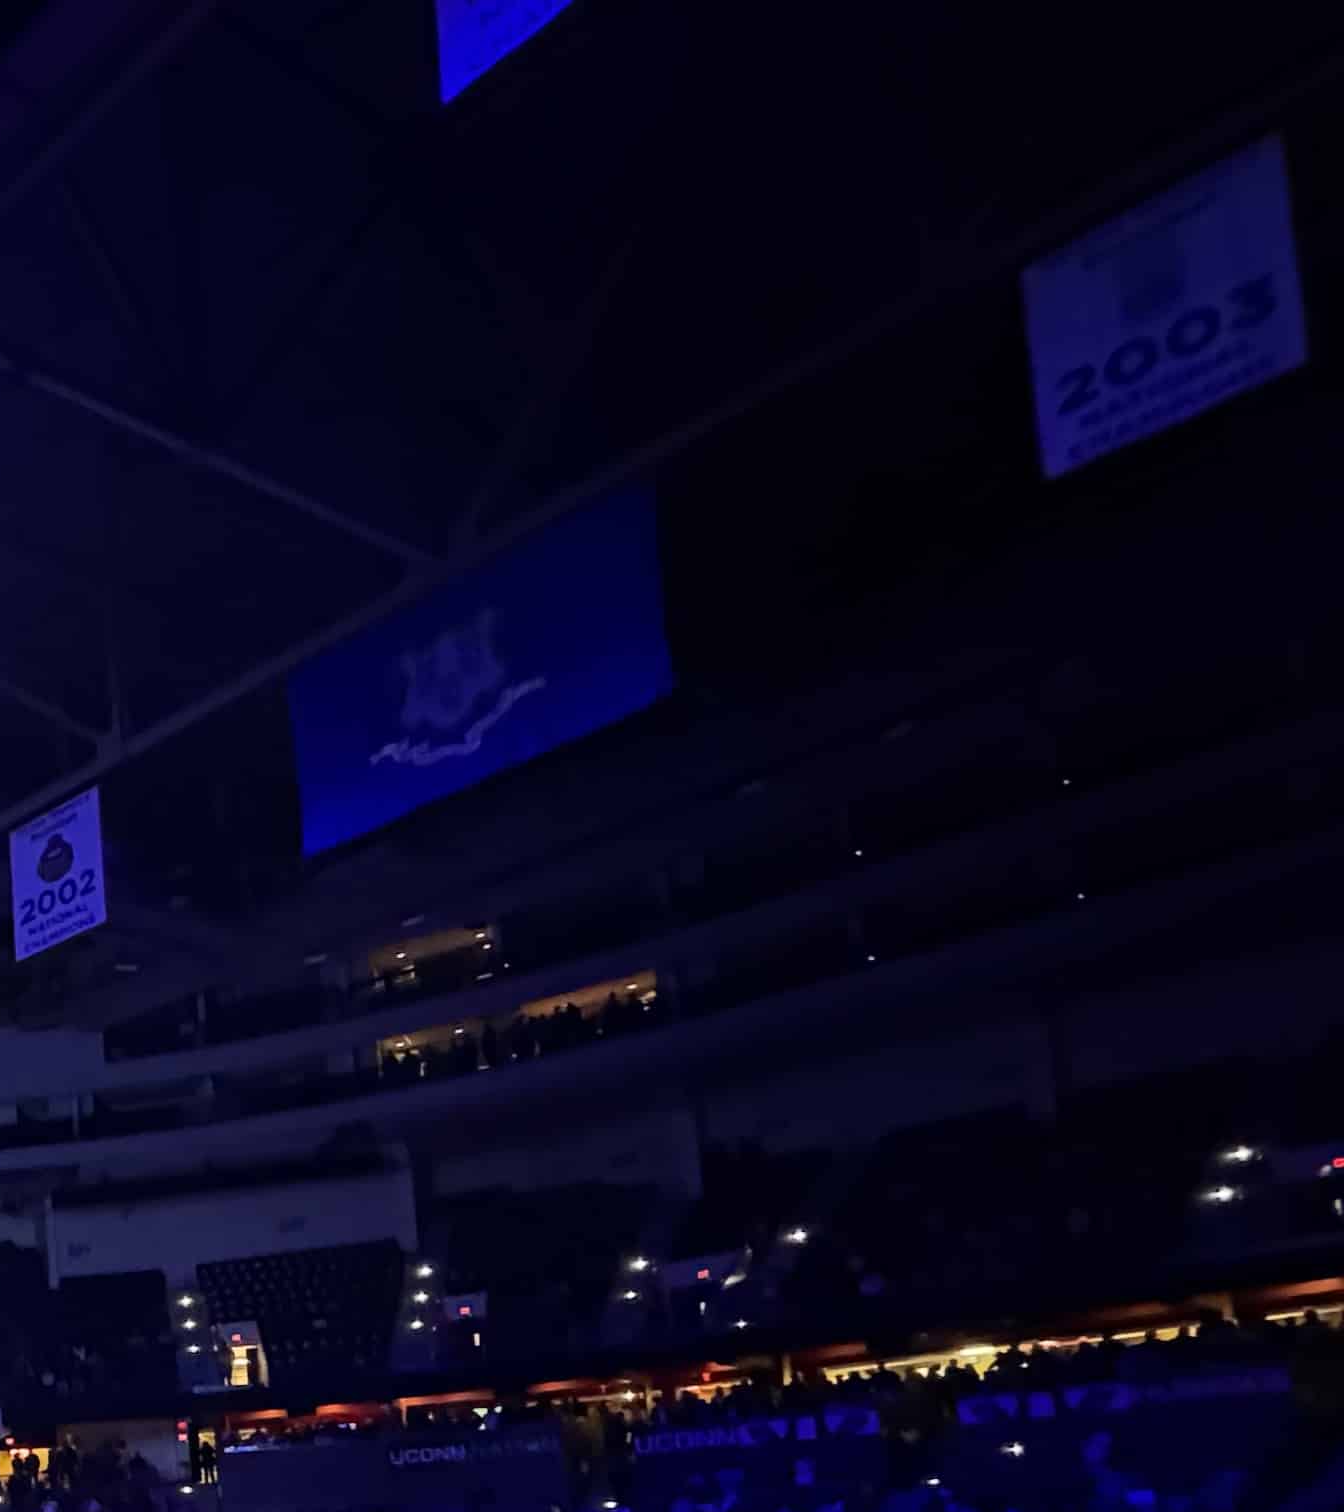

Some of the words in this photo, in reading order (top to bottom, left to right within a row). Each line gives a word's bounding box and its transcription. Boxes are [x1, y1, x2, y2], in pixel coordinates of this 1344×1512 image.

[1058, 272, 1277, 416] 2003
[20, 869, 96, 926] 2002
[389, 1443, 467, 1465] UCONN
